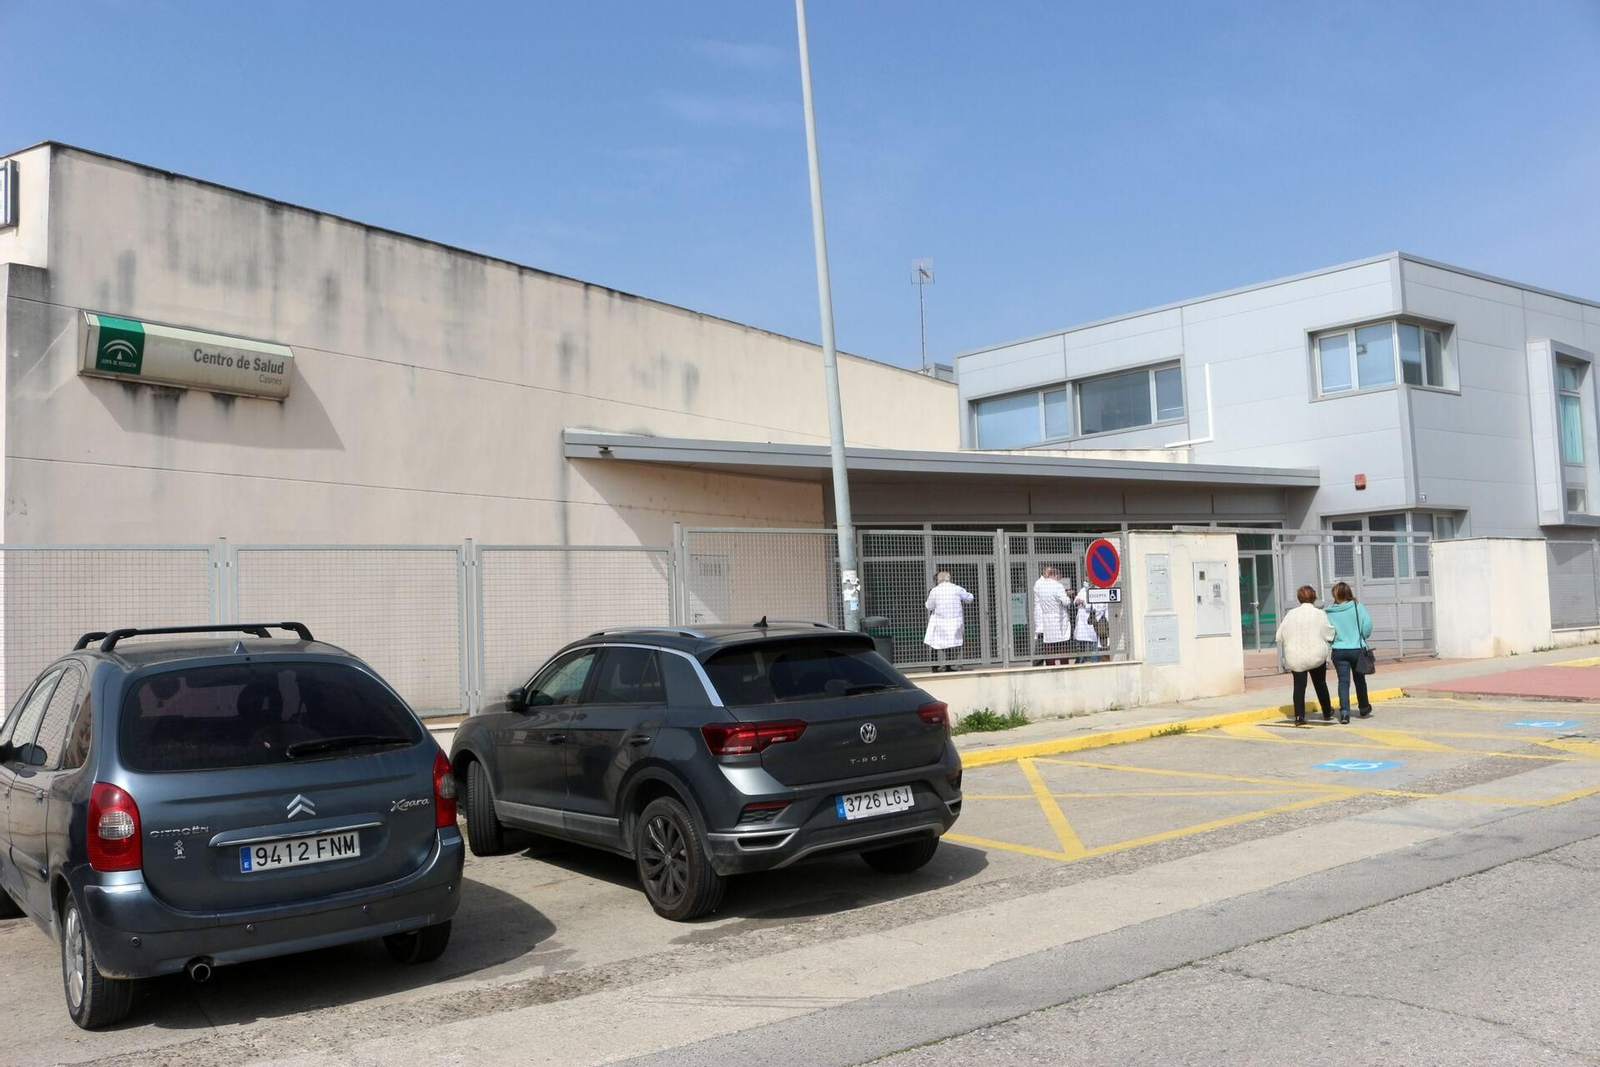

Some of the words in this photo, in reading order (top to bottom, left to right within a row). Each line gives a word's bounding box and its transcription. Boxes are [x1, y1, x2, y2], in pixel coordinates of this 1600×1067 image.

[193, 348, 234, 367] Centro
[236, 355, 250, 370] de
[253, 357, 284, 375] Salud
[259, 374, 282, 386] Casines
[850, 754, 887, 765] T-ROC
[390, 798, 430, 812] Xsara
[846, 792, 881, 813] 3726
[883, 788, 910, 806] LGJ
[149, 825, 209, 838] CITROËN
[255, 841, 310, 867] 9412
[316, 834, 355, 859] FNM
